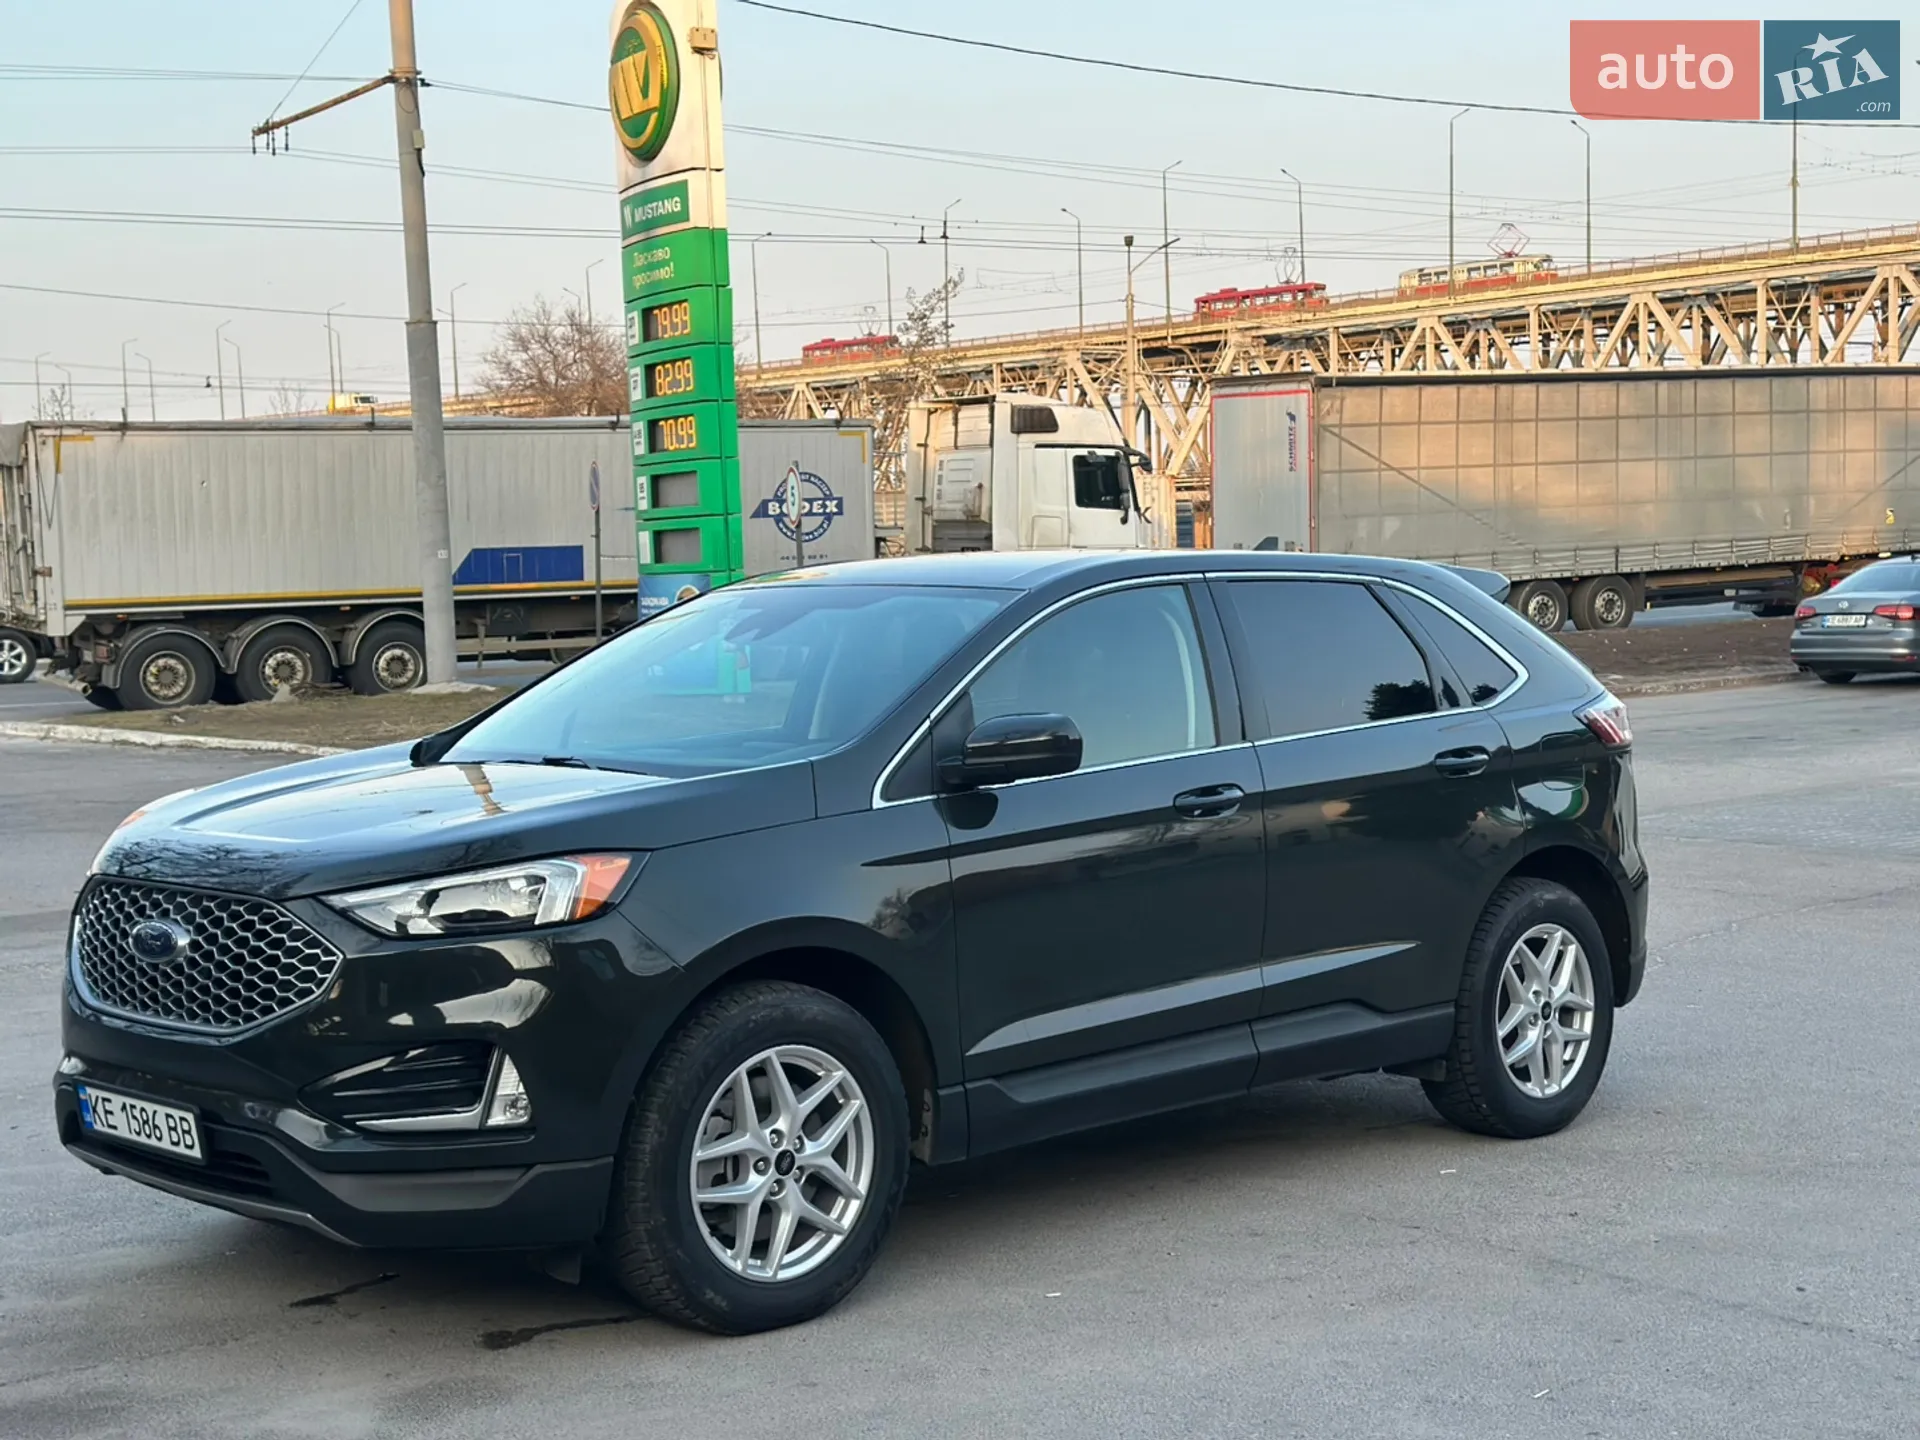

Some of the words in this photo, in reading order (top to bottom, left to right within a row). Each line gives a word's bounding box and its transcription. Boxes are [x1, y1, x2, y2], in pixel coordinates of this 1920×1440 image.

[634, 196, 681, 223] MUSTANG
[653, 302, 691, 339] 79.99
[655, 359, 694, 396] 82.99
[659, 416, 697, 451] 70.99
[791, 485, 796, 506] 5
[88, 1093, 118, 1131] KE
[120, 1101, 163, 1143] 1586
[164, 1112, 196, 1150] BB
